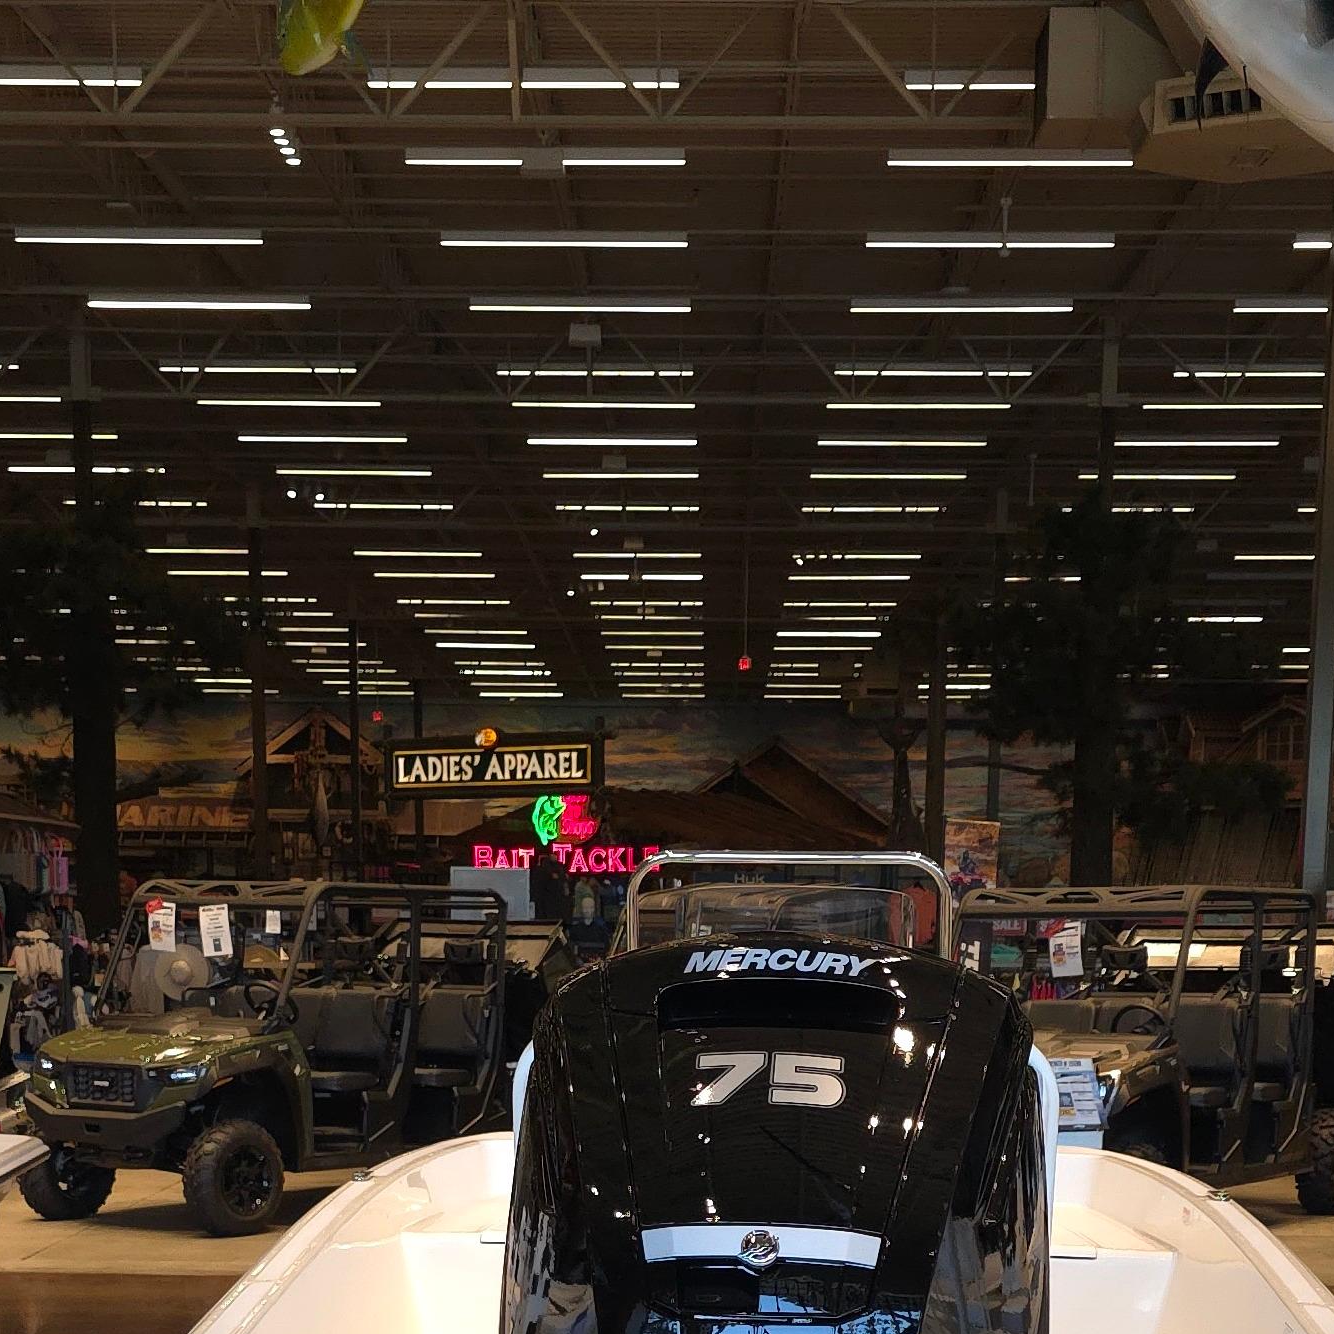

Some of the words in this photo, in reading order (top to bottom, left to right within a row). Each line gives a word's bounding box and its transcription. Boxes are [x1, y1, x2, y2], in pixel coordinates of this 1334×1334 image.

[484, 751, 584, 780] APPAREL
[116, 803, 251, 829] ARINE
[683, 948, 877, 977] MERCURY
[690, 1050, 847, 1109] 75
